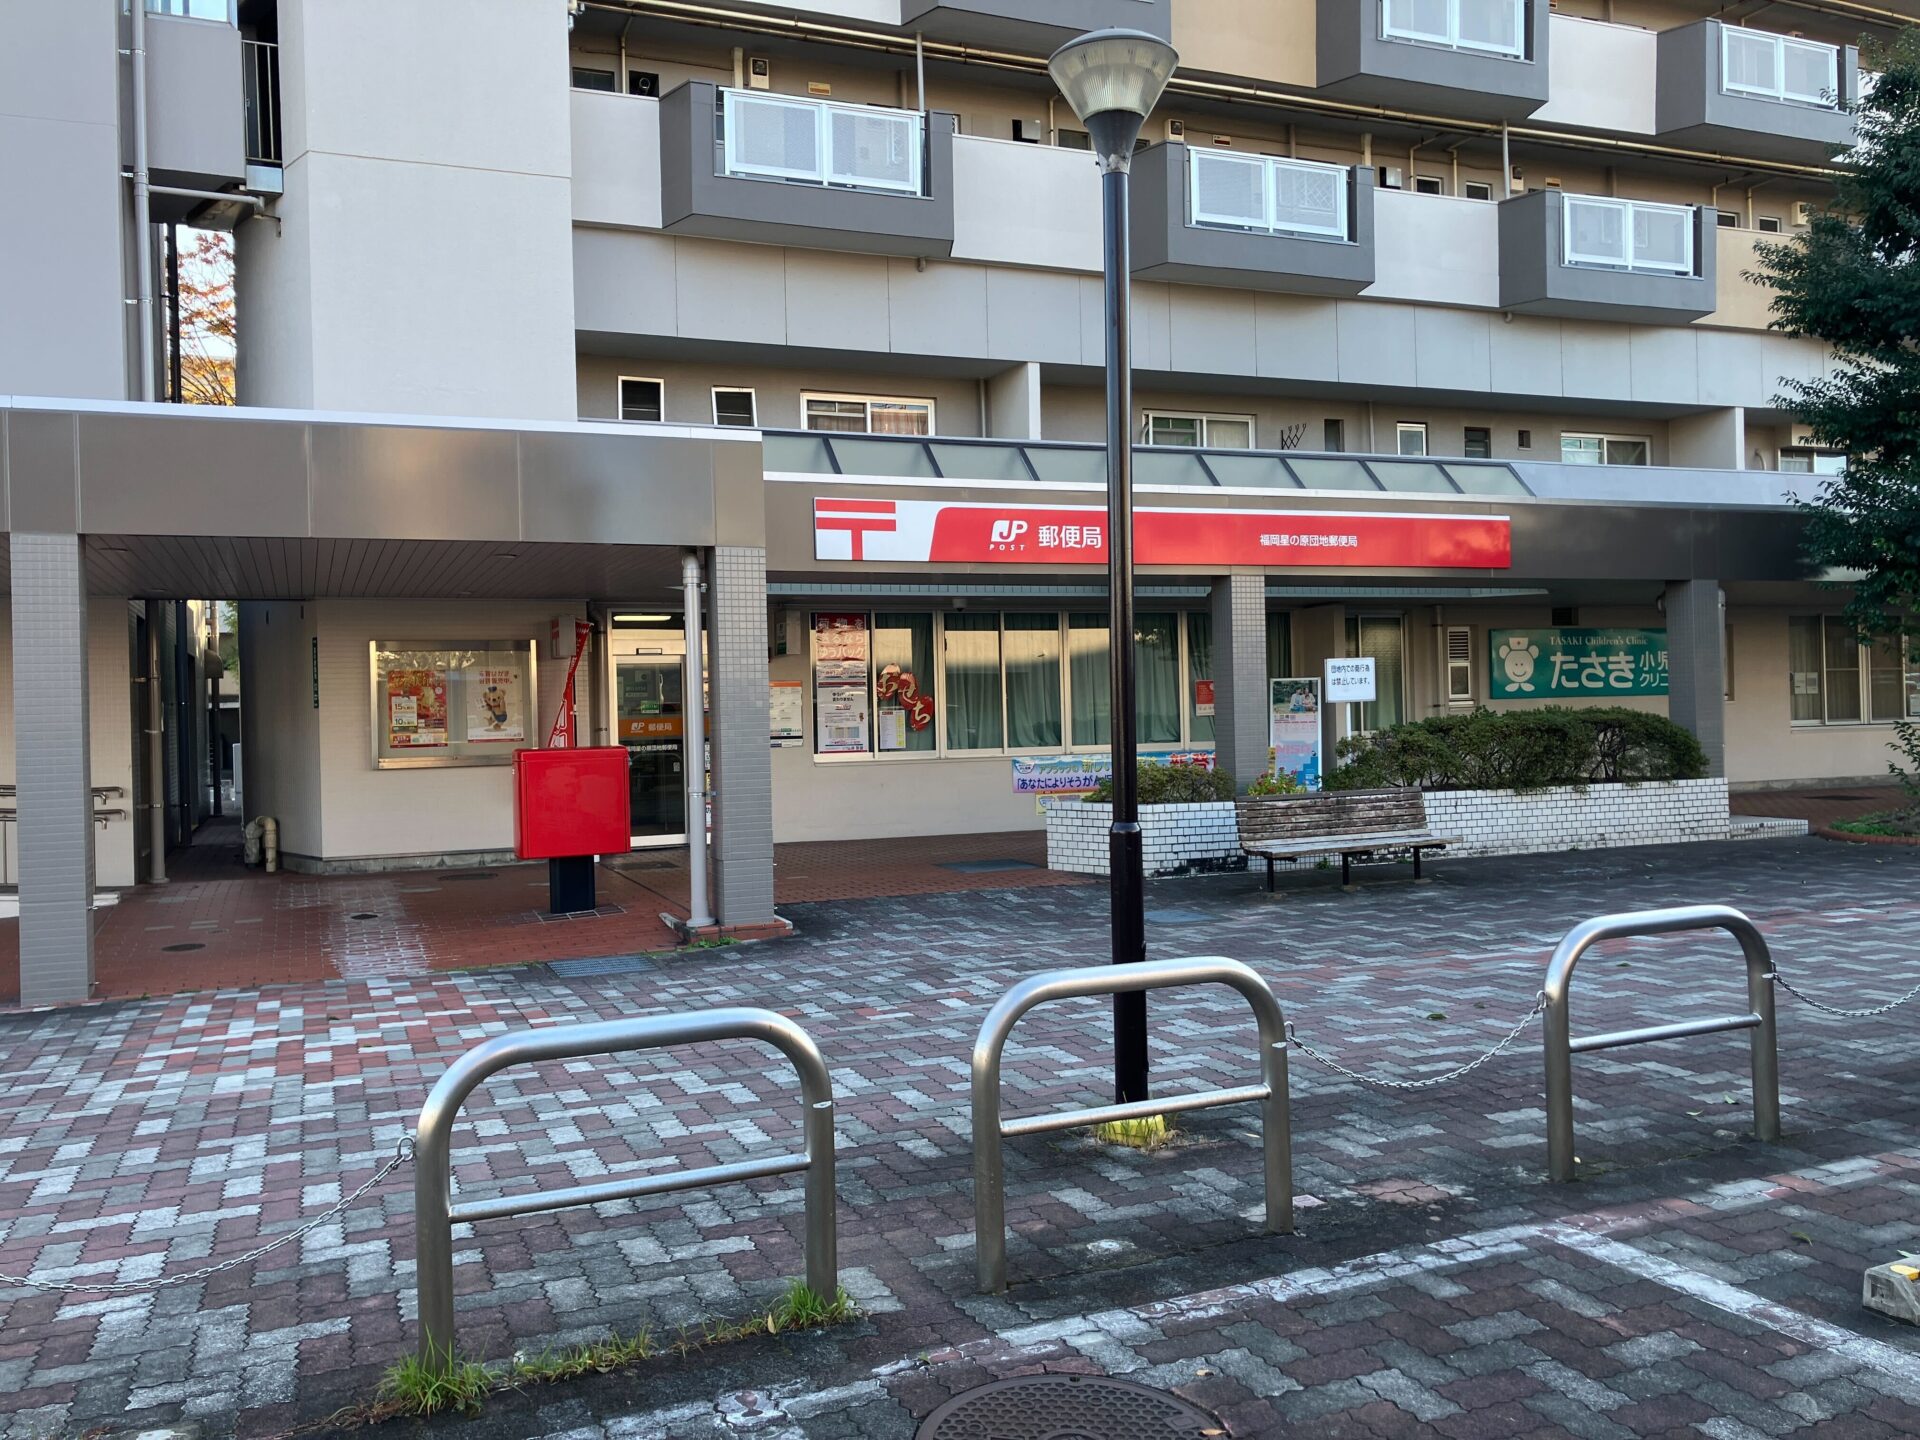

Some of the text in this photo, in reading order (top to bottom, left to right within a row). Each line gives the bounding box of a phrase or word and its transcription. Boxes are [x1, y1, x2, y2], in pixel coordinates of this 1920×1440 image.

[1038, 525, 1102, 549] 郵便局
[1260, 533, 1358, 548] 福岡星の原団地郵便局
[1550, 635, 1649, 646] TASAKI Children's Clinic
[1550, 651, 1636, 689] たさき
[877, 670, 931, 725] おせち
[648, 722, 672, 732] 郵便局
